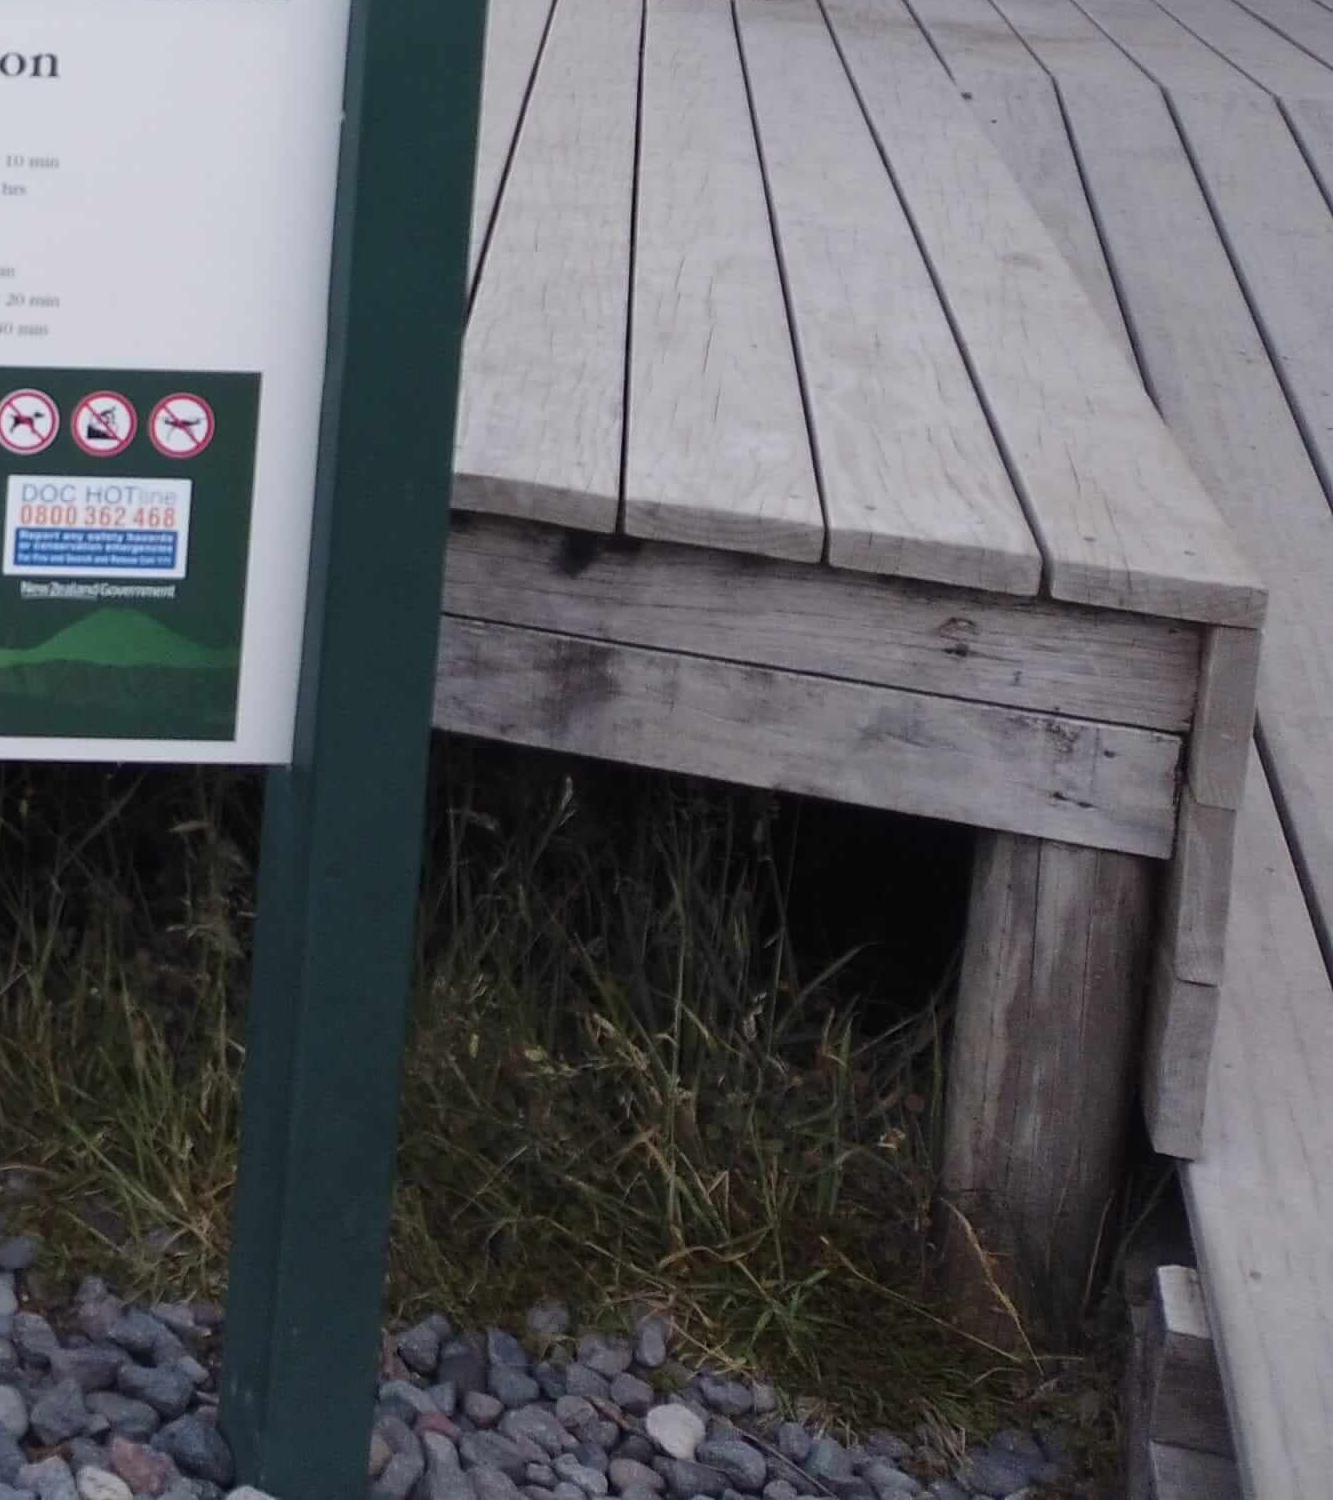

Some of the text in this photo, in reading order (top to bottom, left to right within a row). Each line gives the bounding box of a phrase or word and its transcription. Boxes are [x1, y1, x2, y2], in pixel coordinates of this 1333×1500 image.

[22, 484, 76, 503] DOC
[20, 505, 176, 528] 0800 362 468
